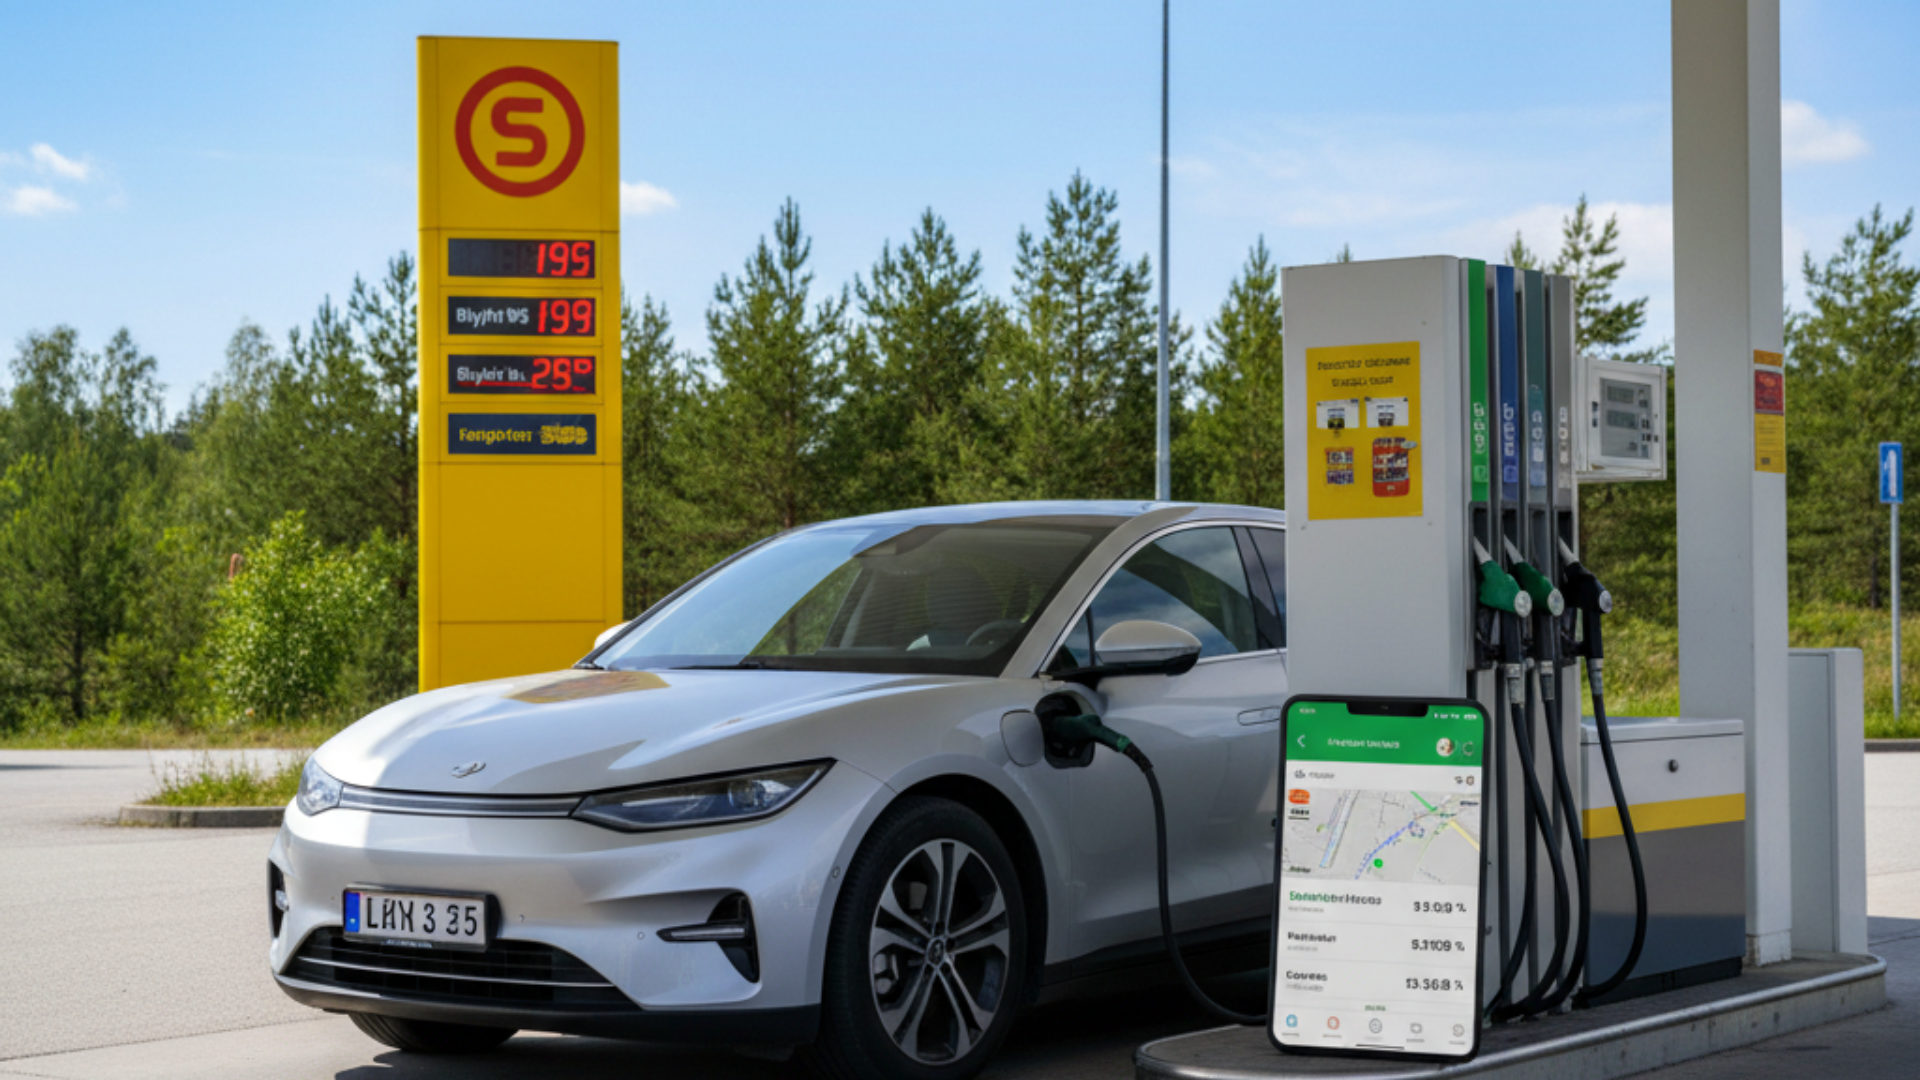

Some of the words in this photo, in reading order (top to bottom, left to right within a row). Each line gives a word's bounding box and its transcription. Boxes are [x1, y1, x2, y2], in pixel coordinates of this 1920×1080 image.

[490, 96, 548, 168] S
[536, 241, 592, 277] 195
[537, 299, 593, 335] 199
